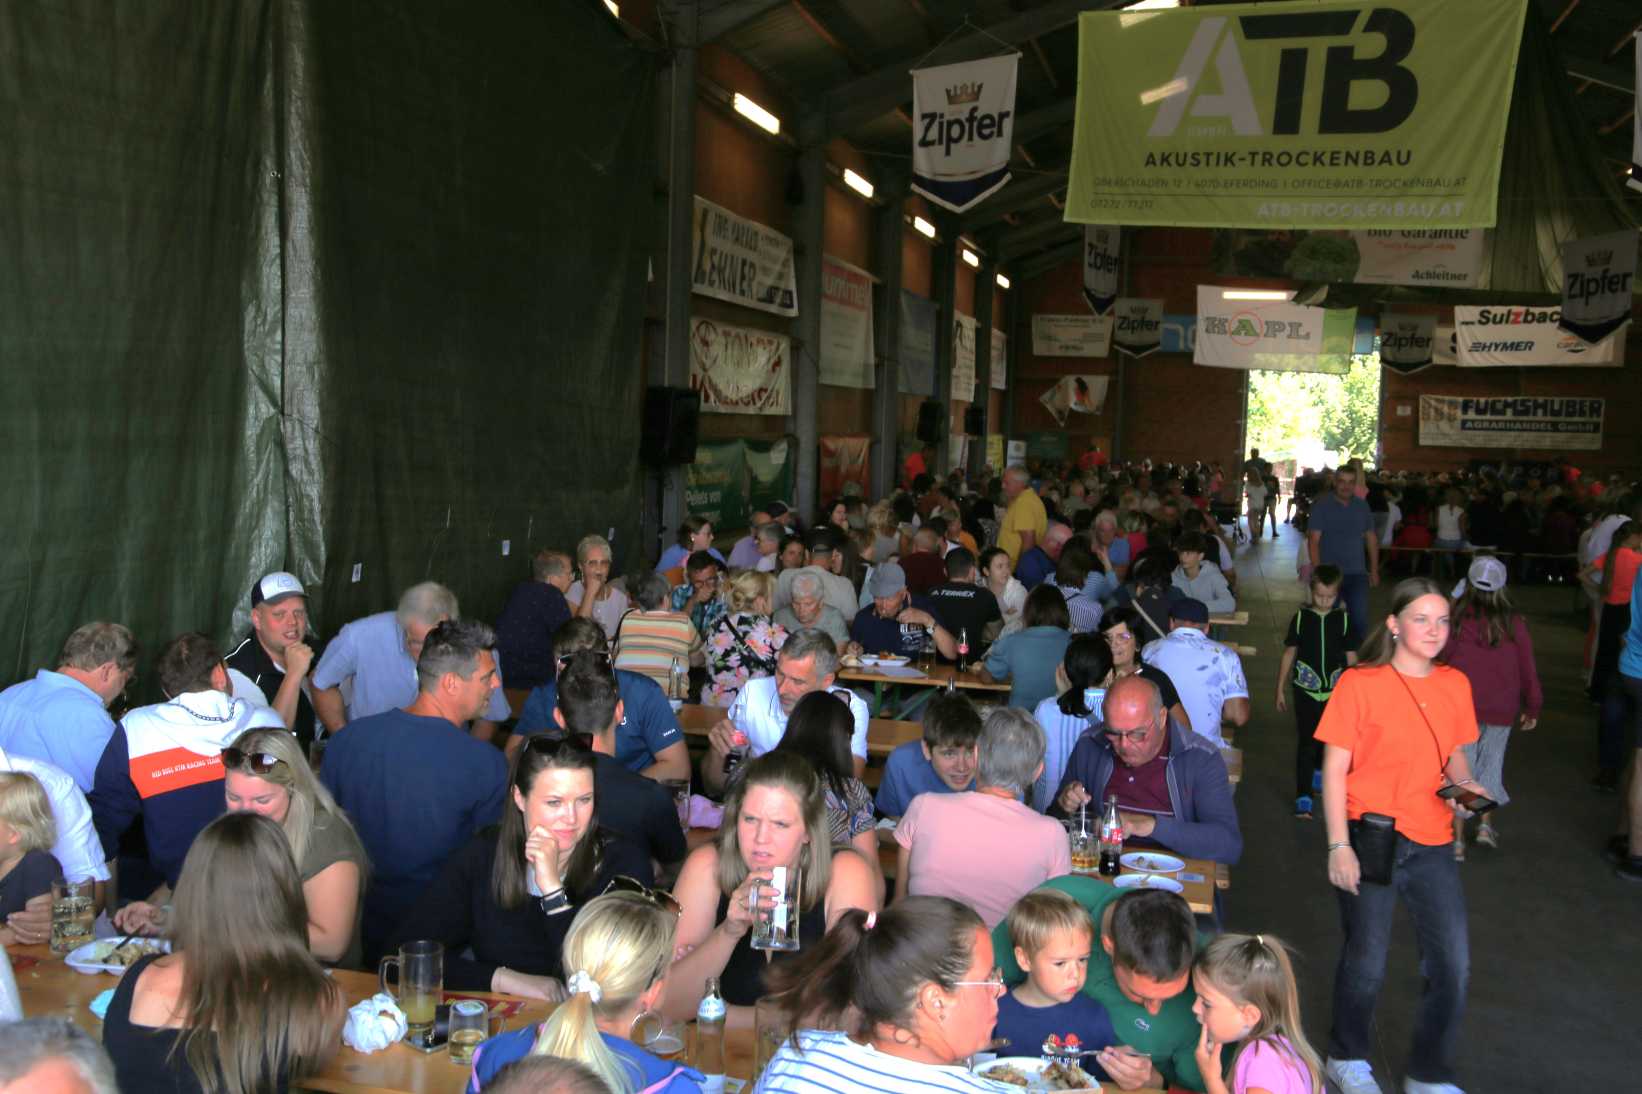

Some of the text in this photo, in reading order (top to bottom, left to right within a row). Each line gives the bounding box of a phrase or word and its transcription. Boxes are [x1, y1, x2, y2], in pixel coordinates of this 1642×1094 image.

[1146, 7, 1419, 137] ATB
[918, 105, 1010, 157] Zipfer
[1144, 150, 1412, 168] AKUSTIK-TROCKENBAU
[1567, 268, 1633, 306] Zipfer
[1117, 316, 1160, 335] Zipfer
[1204, 316, 1311, 340] KAPL
[1382, 332, 1433, 352] Zipfer
[1481, 341, 1535, 352] HYMER
